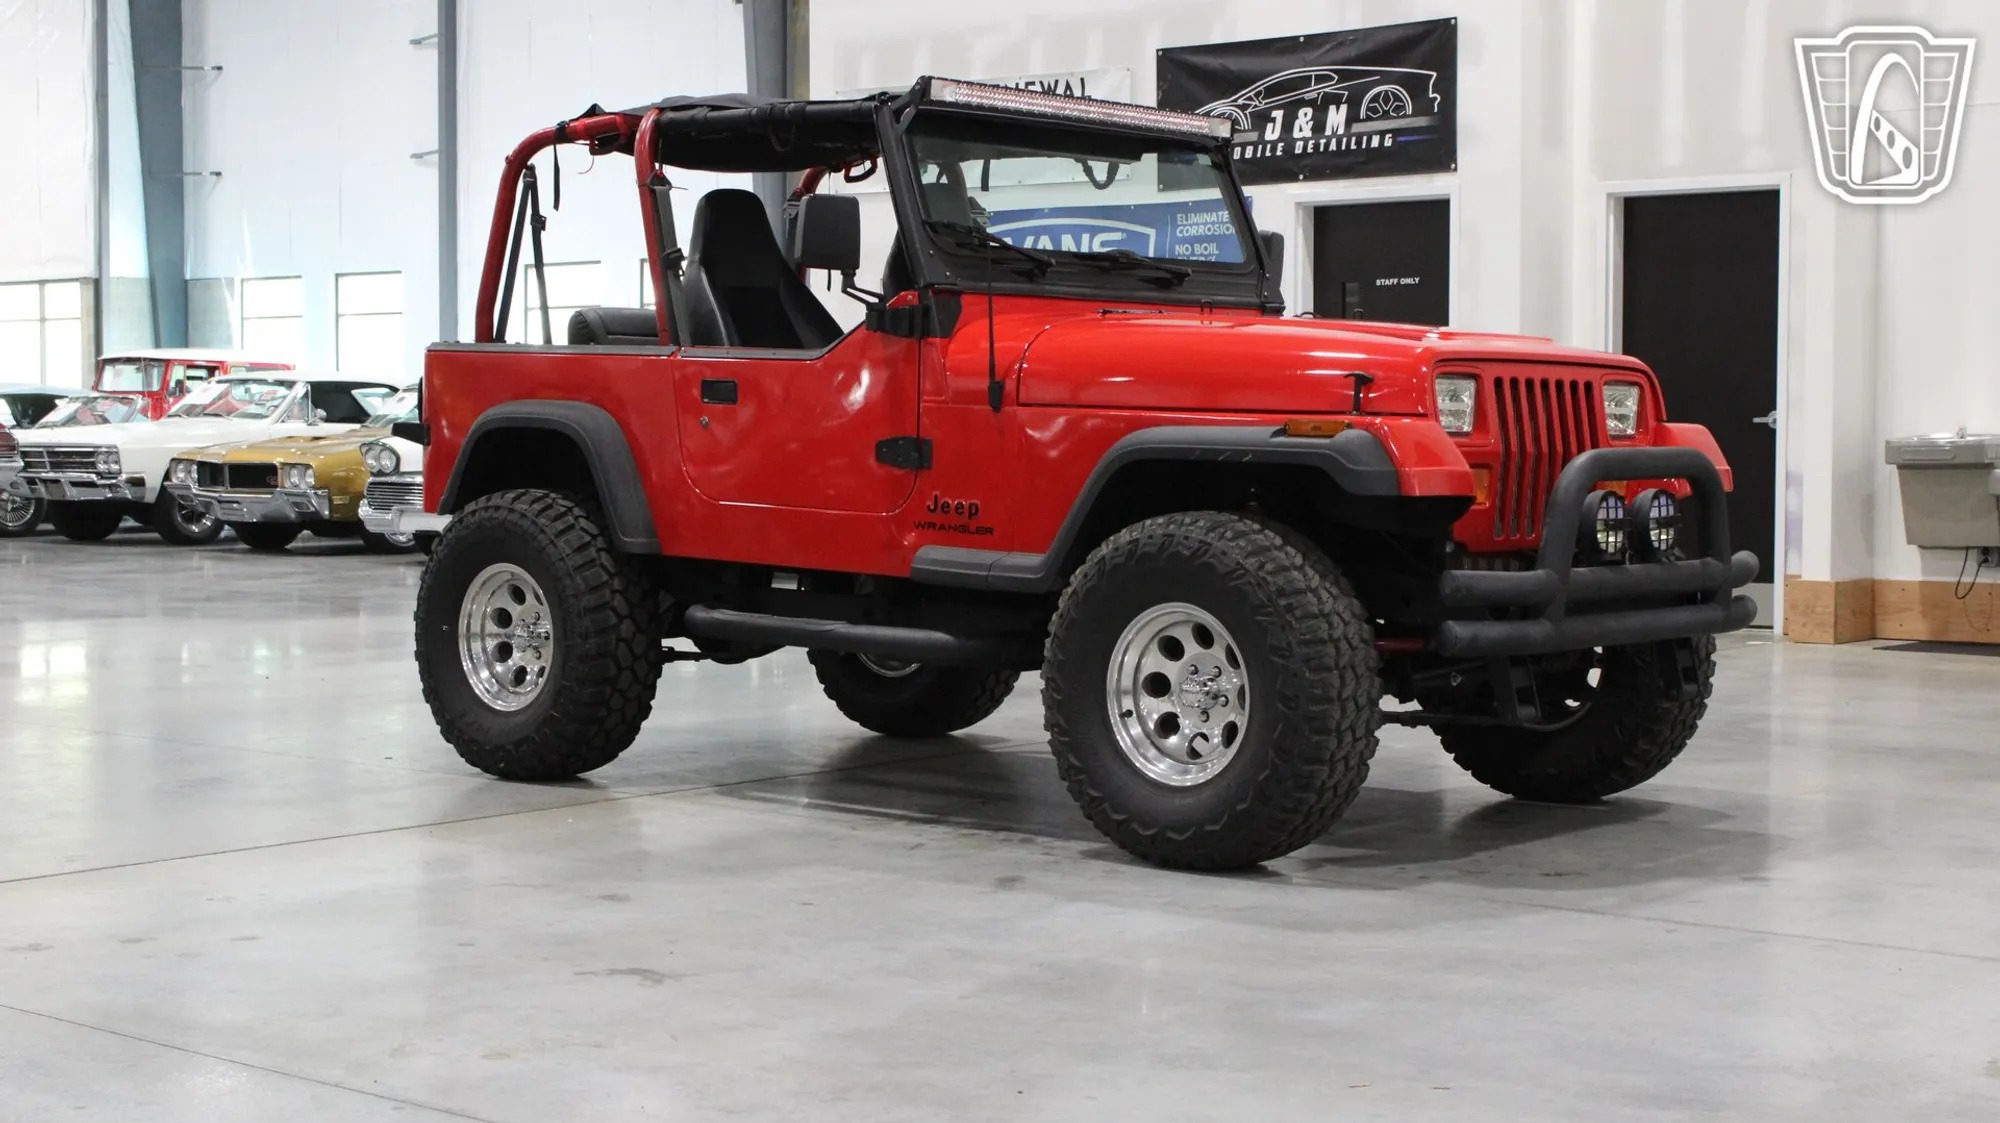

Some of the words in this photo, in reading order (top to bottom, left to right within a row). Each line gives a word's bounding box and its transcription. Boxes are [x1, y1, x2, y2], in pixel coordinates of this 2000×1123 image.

[1264, 109, 1284, 141] J
[1292, 107, 1314, 139] &
[1324, 103, 1348, 137] M
[1233, 142, 1285, 160] OBILE
[1294, 133, 1393, 155] DETAILING
[1176, 211, 1229, 225] ELIMINATE
[1176, 223, 1236, 237] CORROSIO
[1175, 243, 1192, 256] NO
[1194, 242, 1220, 255] BOIL
[1375, 278, 1399, 286] STAFF
[1399, 276, 1420, 285] ONLY
[926, 493, 980, 521] Jeep
[913, 520, 995, 536] WRANGLER
